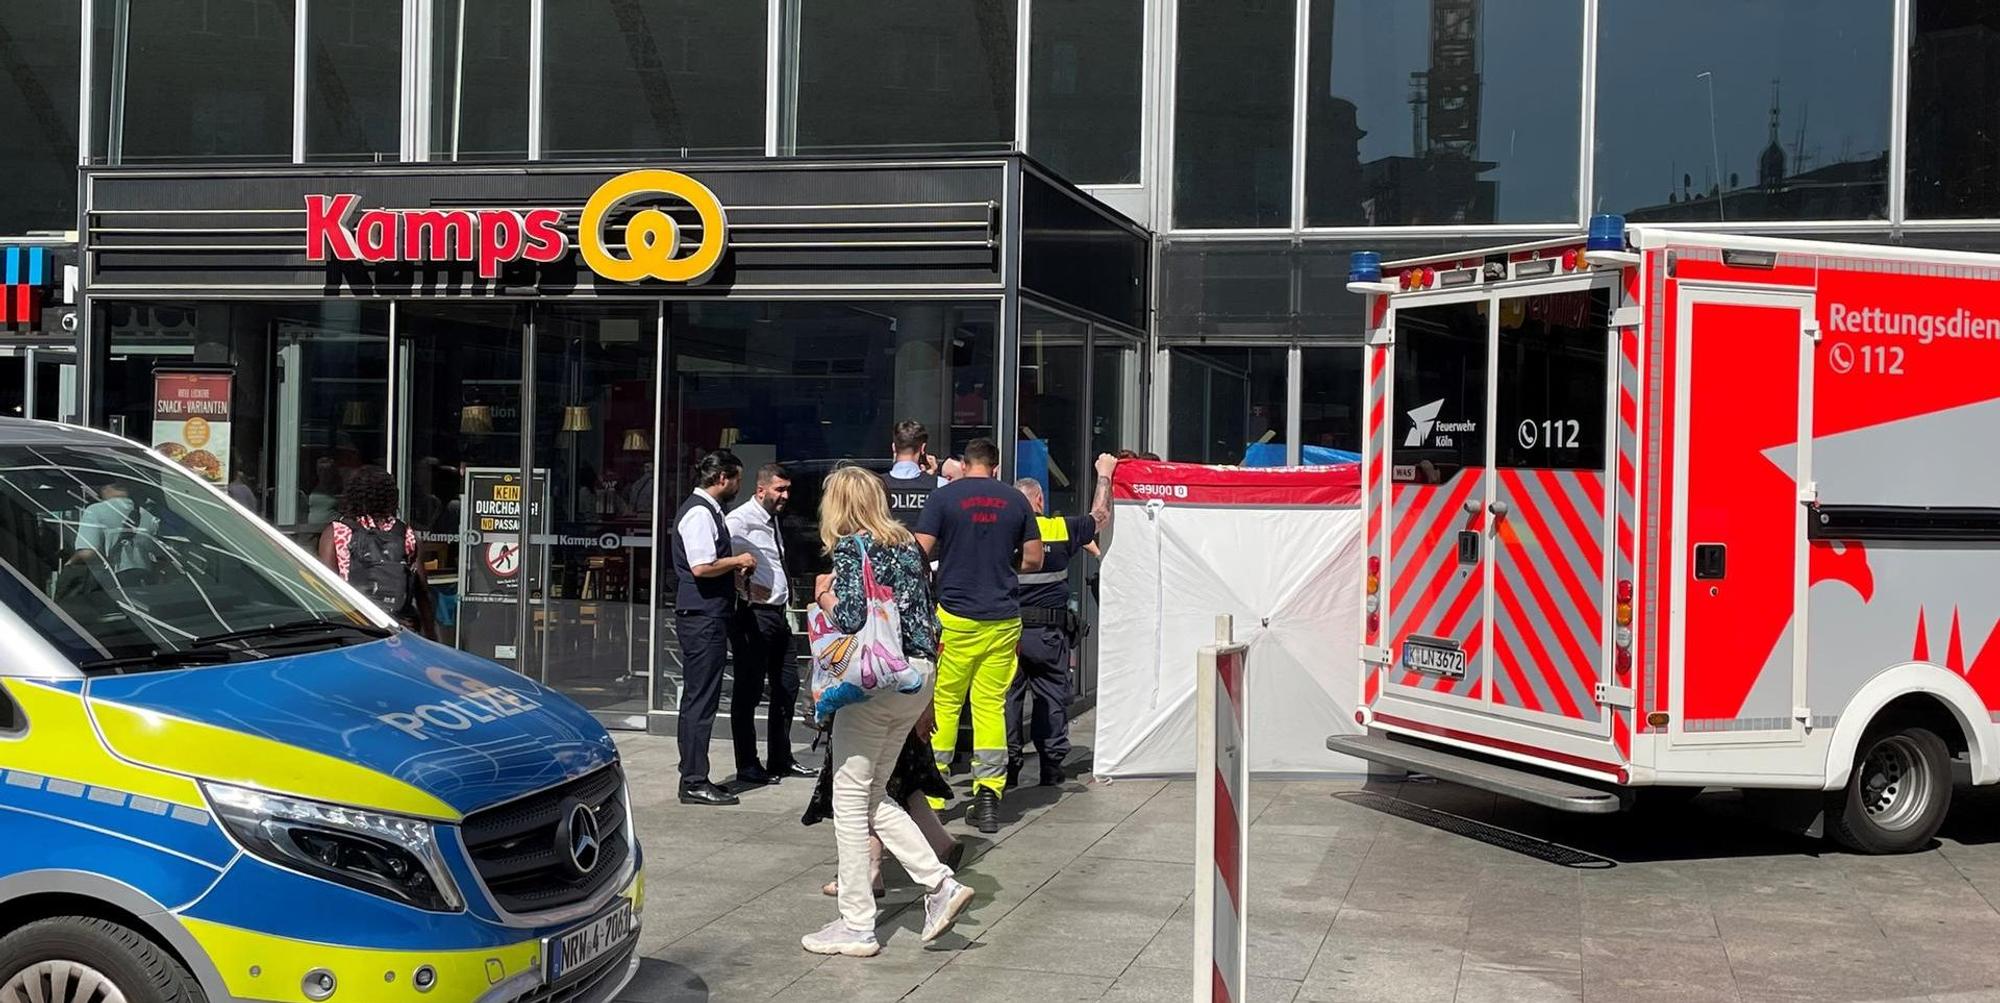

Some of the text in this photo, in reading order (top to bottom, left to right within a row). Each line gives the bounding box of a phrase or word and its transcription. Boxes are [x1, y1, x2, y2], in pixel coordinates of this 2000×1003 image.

[304, 194, 568, 279] Kamps
[1829, 303, 2000, 344] Rettungsdien
[1860, 345, 1904, 375] 112
[1435, 420, 1476, 432] Feuerwehr
[1541, 419, 1581, 448] 112
[1435, 435, 1454, 447] Köln
[495, 487, 520, 500] KEIN
[891, 493, 929, 509] OLIZE
[494, 519, 520, 530] PASSA
[423, 531, 460, 544] Kamps
[560, 534, 598, 548] Kamps
[376, 684, 544, 741] POLIZEI
[561, 930, 588, 972] NRW
